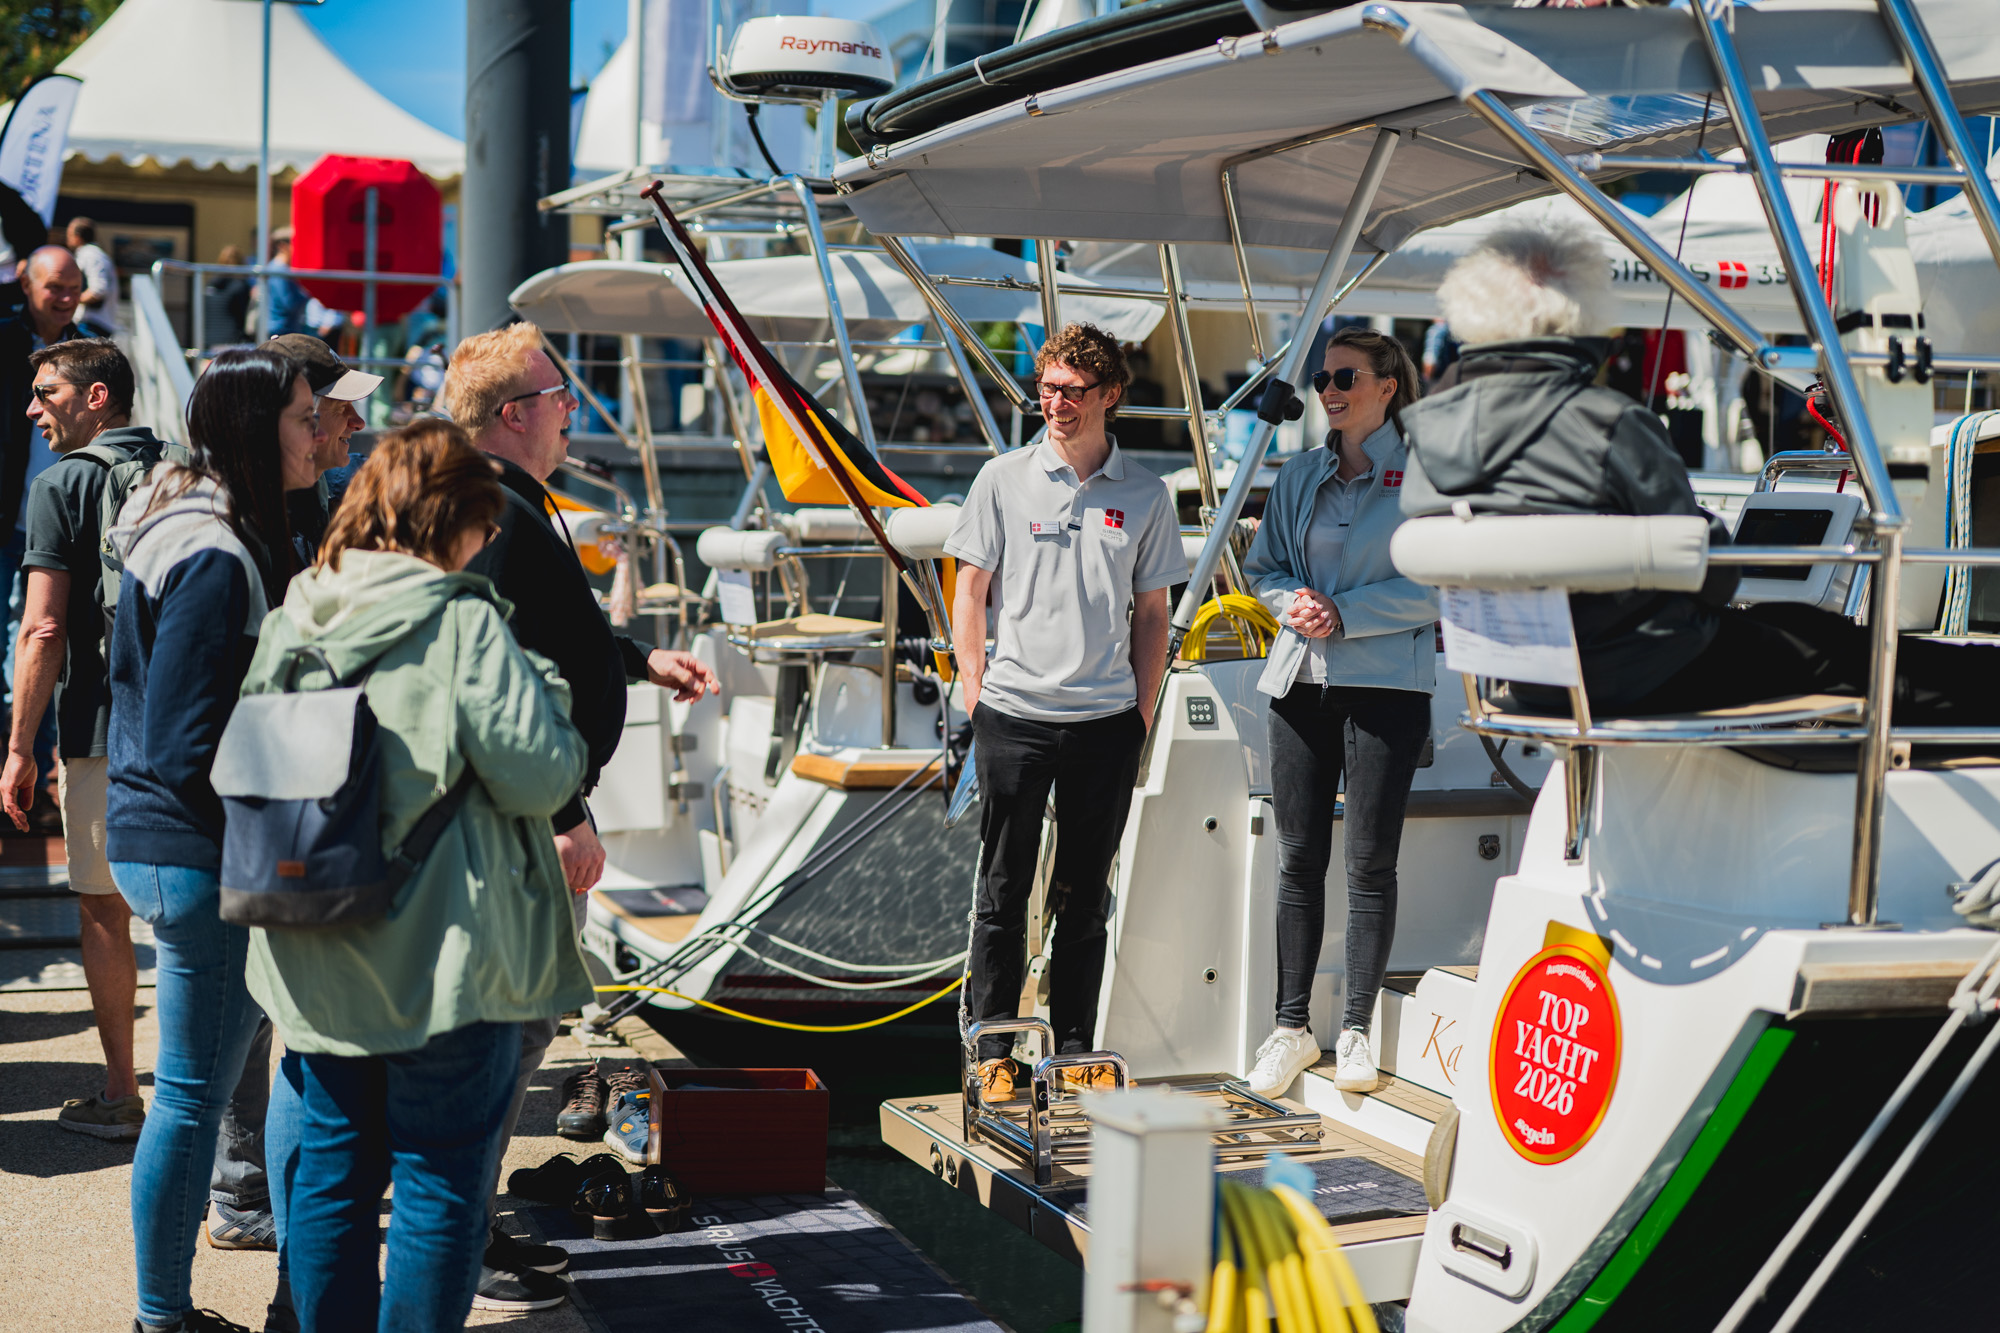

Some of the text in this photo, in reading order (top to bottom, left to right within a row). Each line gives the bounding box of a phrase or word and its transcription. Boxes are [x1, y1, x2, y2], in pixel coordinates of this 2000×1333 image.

[780, 36, 882, 59] Raymarine
[1609, 258, 1711, 284] SIRS
[1537, 990, 1590, 1039] TOP
[1514, 1020, 1599, 1084] YACHT
[1514, 1061, 1577, 1116] 2026
[1514, 1118, 1556, 1145] segeln
[691, 1215, 756, 1261] SIRIUS
